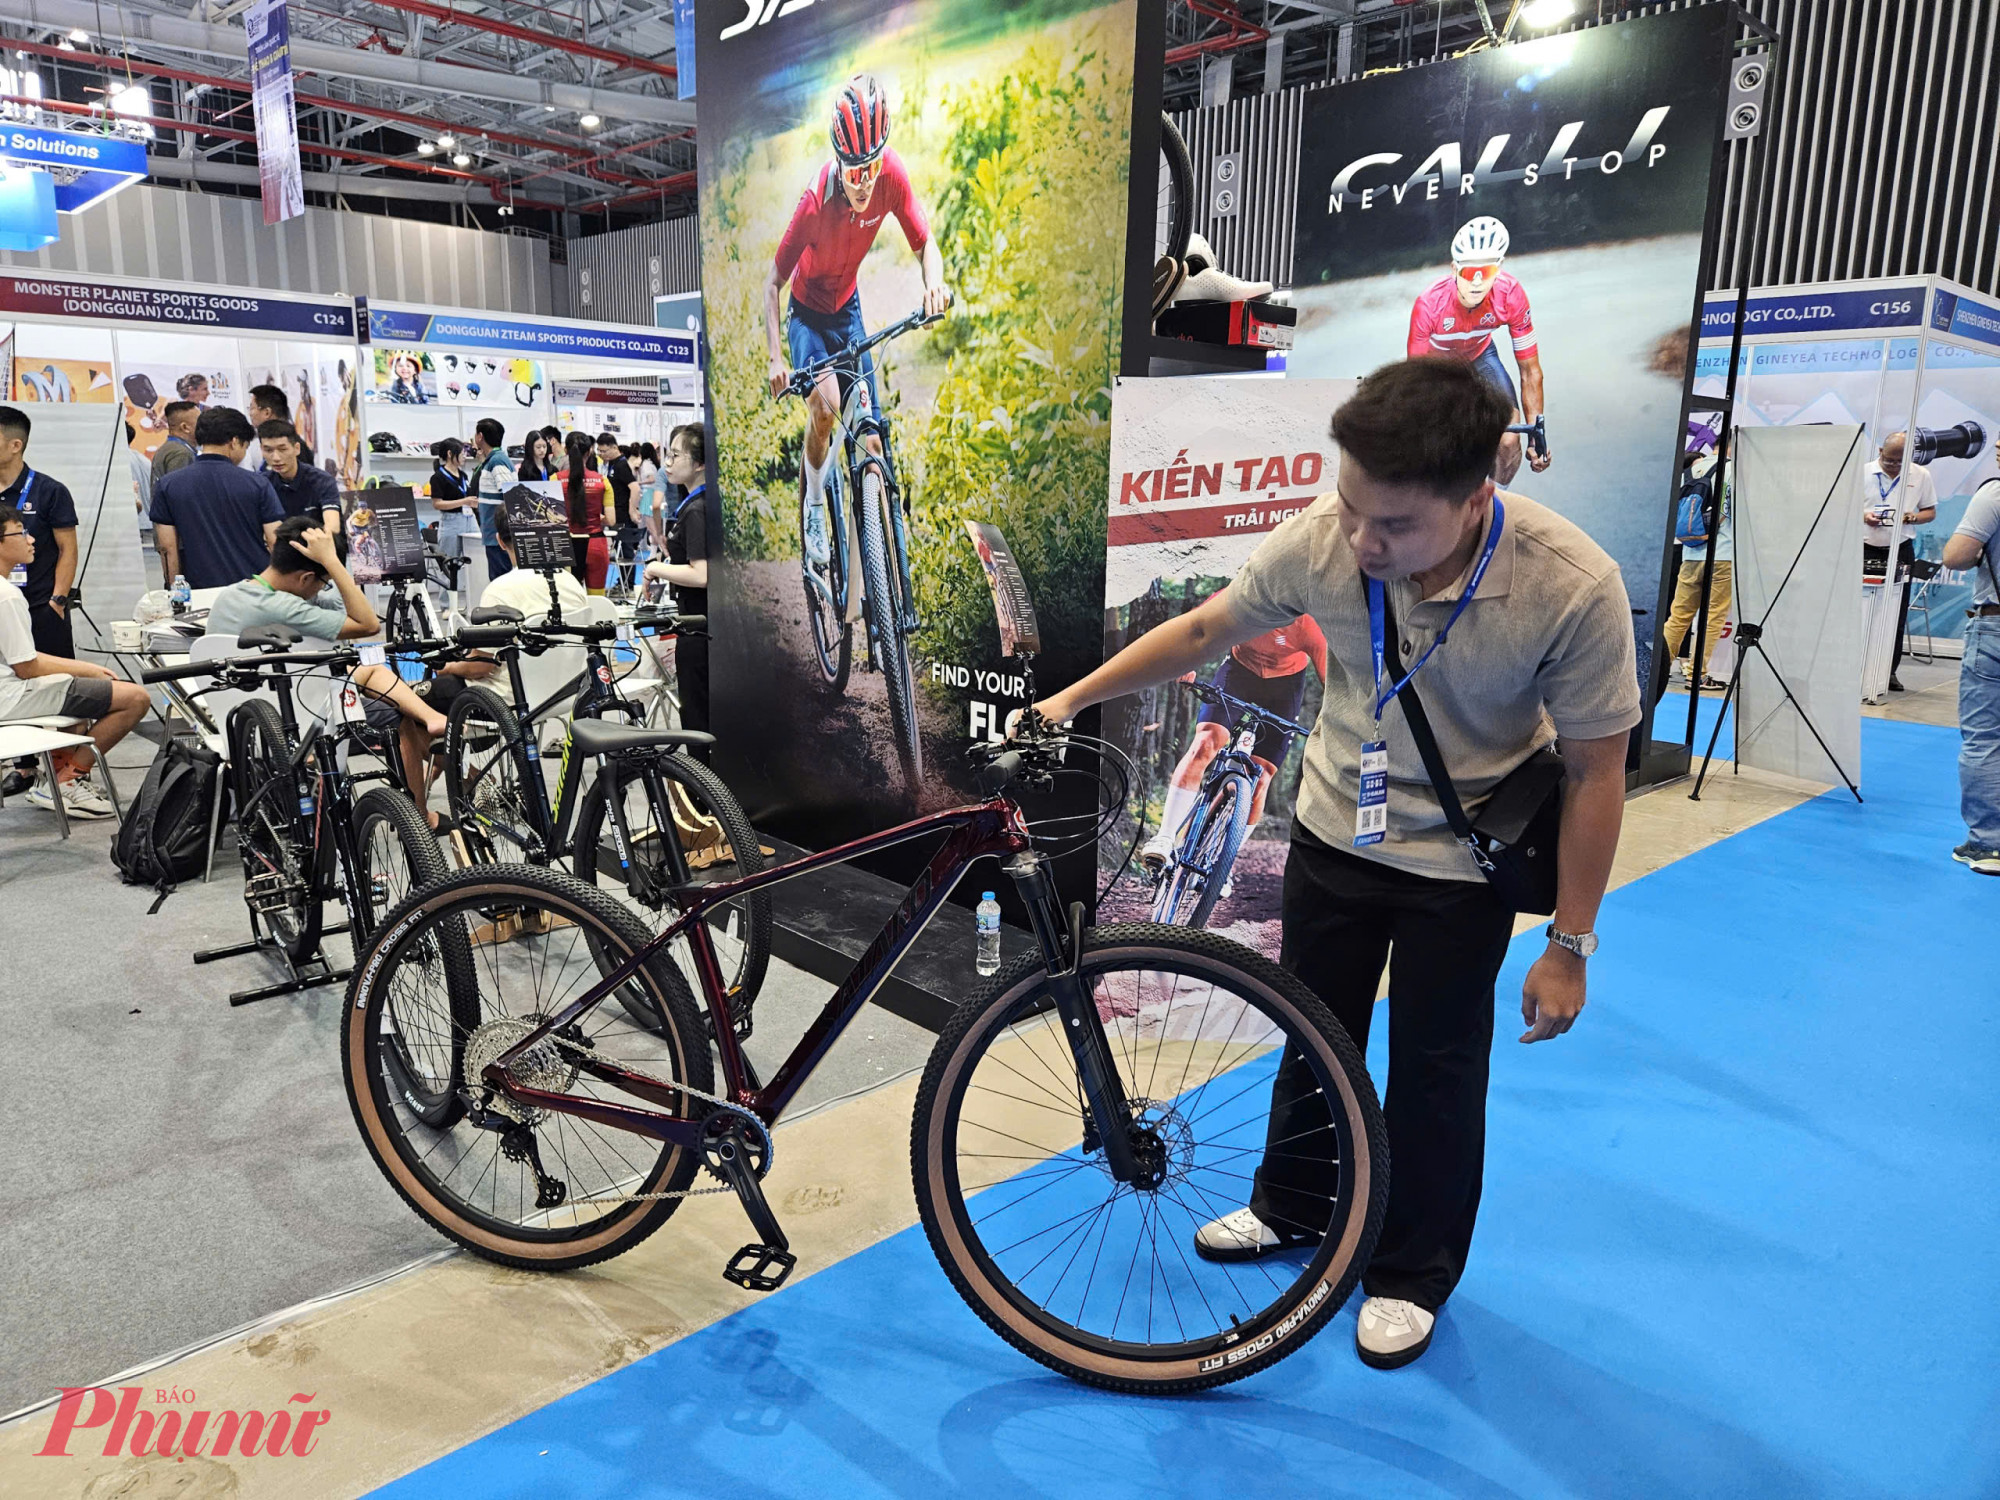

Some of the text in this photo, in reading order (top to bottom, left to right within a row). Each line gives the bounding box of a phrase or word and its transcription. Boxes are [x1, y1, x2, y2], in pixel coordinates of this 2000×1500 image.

[11, 133, 100, 159] Solutions
[1328, 144, 1666, 214] NEVER STOP
[14, 281, 259, 312] MONSTER PLANET SPORTS GOODS
[1870, 301, 1911, 316] C156
[63, 298, 220, 322] (DONGGUAN) CO.,LTD.
[313, 313, 345, 326] C124
[1774, 305, 1836, 321] CO.,LTD.
[436, 323, 663, 354] DONGGUAN ZTEAM SPORTS PRODUCTS CO.,LTD.
[667, 345, 689, 356] C123
[1756, 353, 1817, 365] GINEYEA
[1823, 348, 1917, 362] TECHNOLOG
[606, 389, 637, 397] DONGGUAN
[1119, 448, 1323, 505] KIẾN TẠO
[1223, 508, 1264, 528] TRẢI
[932, 662, 1025, 699] FIND YOUR
[357, 910, 423, 1009] INNOVA-PRO CROSS FIT
[404, 1090, 426, 1114] KENDA
[1201, 1280, 1330, 1372] INNOVA-PRO CROSS FIT
